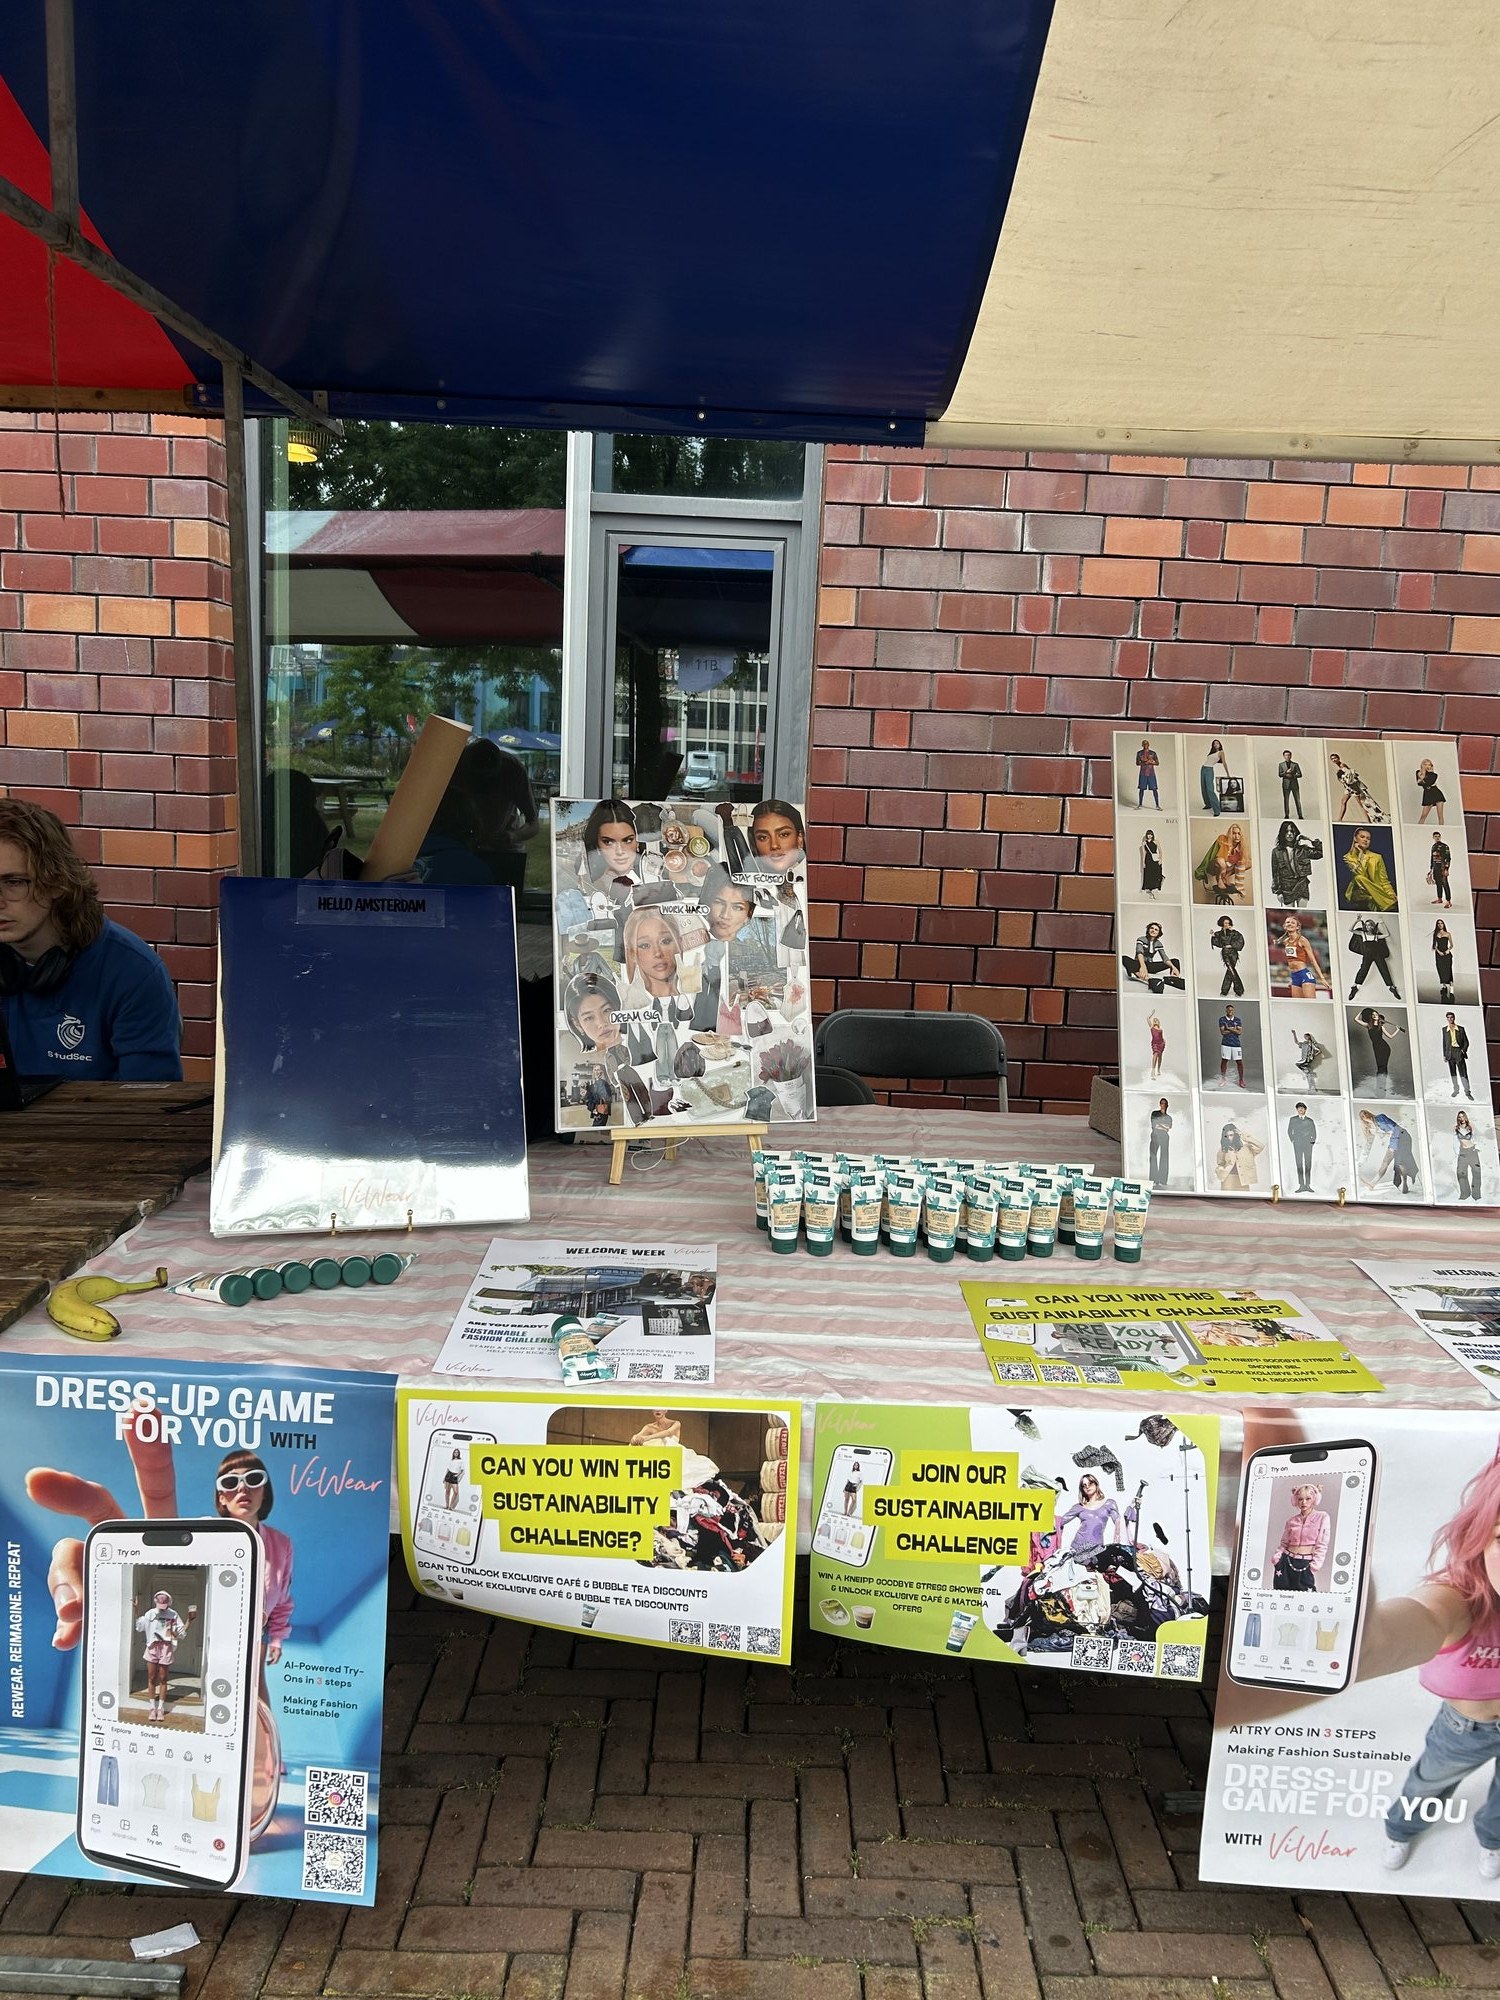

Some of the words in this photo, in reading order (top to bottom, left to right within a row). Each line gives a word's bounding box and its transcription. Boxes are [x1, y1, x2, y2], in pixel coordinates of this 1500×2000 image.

[695, 658, 718, 671] 11B
[733, 874, 750, 882] STAY
[318, 896, 352, 911] HELLO
[355, 898, 426, 912] AMSTERDAM
[661, 906, 684, 914] WORK
[685, 905, 709, 914] HARD
[611, 1012, 642, 1023] DREAM
[643, 1010, 662, 1022] BIG
[48, 1050, 92, 1062] StudSec
[339, 1178, 413, 1209] ViWear
[566, 1247, 628, 1255] WELCOME
[1432, 1269, 1498, 1278] WELCOME
[1035, 1294, 1080, 1304] CAN
[1082, 1294, 1122, 1304] YOU
[1126, 1293, 1166, 1302] WIN
[1168, 1292, 1215, 1301] THIS
[990, 1307, 1152, 1320] SUSTAINABILITY
[1156, 1304, 1283, 1317] CHALLENGE?
[461, 1334, 503, 1342] FASHION
[463, 1327, 528, 1336] SUSTAINABLE
[1062, 1323, 1108, 1336] ARE
[1078, 1337, 1169, 1353] READY?
[36, 1376, 220, 1418] DRESS-UP
[228, 1386, 335, 1425] GAME
[416, 1402, 469, 1427] ViWear
[114, 1411, 182, 1444] FOR
[190, 1416, 262, 1450] YOU
[270, 1432, 316, 1450] WITH
[290, 1455, 384, 1498] ViWear
[481, 1456, 526, 1476] CAN
[532, 1458, 574, 1477] YOU
[580, 1458, 619, 1478] WIN
[625, 1459, 671, 1479] THIS
[912, 1463, 960, 1484] JOIN
[966, 1464, 1006, 1484] OUR
[493, 1492, 659, 1515] SUSTAINABILITY
[874, 1498, 1043, 1522] SUSTAINABILITY
[510, 1526, 642, 1552] CHALLENGE?
[896, 1532, 1018, 1556] CHALLENGE
[117, 1549, 129, 1557] Try
[8, 1541, 21, 1588] REPEAT
[418, 1560, 444, 1571] SCAN
[446, 1564, 459, 1573] TO
[462, 1566, 500, 1578] UNLOCK
[502, 1571, 554, 1584] EXCLUSIVE
[556, 1575, 581, 1588] CAFÉ
[584, 1579, 590, 1588] &
[592, 1580, 628, 1592] BUBBLE
[631, 1584, 650, 1595] TEA
[653, 1586, 708, 1599] DISCOUNTS
[818, 1572, 834, 1580] WIN
[844, 1574, 874, 1584] KNEIPP
[876, 1578, 914, 1588] GOODBYE
[916, 1582, 947, 1592] STRESS
[949, 1585, 984, 1595] SHOWER
[446, 1576, 483, 1587] UNLOCK
[486, 1582, 536, 1594] EXCLUSIVE
[539, 1586, 563, 1598] CAFÉ
[566, 1591, 572, 1600] &
[574, 1592, 611, 1604] BUBBLE
[613, 1597, 632, 1607] TEA
[634, 1599, 689, 1612] DISCOUNTS
[838, 1586, 872, 1596] UNLOCK
[874, 1590, 919, 1601] EXCLUSIVE
[921, 1594, 942, 1604] CAFÉ
[952, 1598, 989, 1608] MATCHA
[892, 1603, 922, 1613] OFFERS
[9, 1591, 22, 1662] REIMAGINE.
[284, 1661, 341, 1673] AI-Powered
[343, 1666, 364, 1677] Try-
[283, 1674, 303, 1684] Ons
[305, 1676, 314, 1684] in
[316, 1677, 323, 1686] 3
[325, 1679, 352, 1688] steps
[10, 1664, 24, 1718] REWEAR.
[283, 1696, 318, 1708] Making
[320, 1699, 358, 1710] Fashion
[283, 1706, 340, 1718] Sustainable
[1230, 1725, 1243, 1735] AI
[1246, 1726, 1272, 1736] TRY
[1274, 1726, 1304, 1737] ONS
[1307, 1728, 1320, 1737] IN
[1324, 1728, 1332, 1738] 3
[1335, 1729, 1377, 1740] STEPS
[1227, 1744, 1274, 1758] Making
[1278, 1746, 1329, 1758] Fashion
[1332, 1749, 1412, 1762] Sustainable
[1224, 1763, 1394, 1794] DRESS-UP
[1222, 1787, 1317, 1816] GAME
[1325, 1792, 1390, 1820] FOR
[1399, 1795, 1468, 1824] YOU
[1224, 1832, 1262, 1846] WITH
[1269, 1825, 1358, 1862] ViWear
